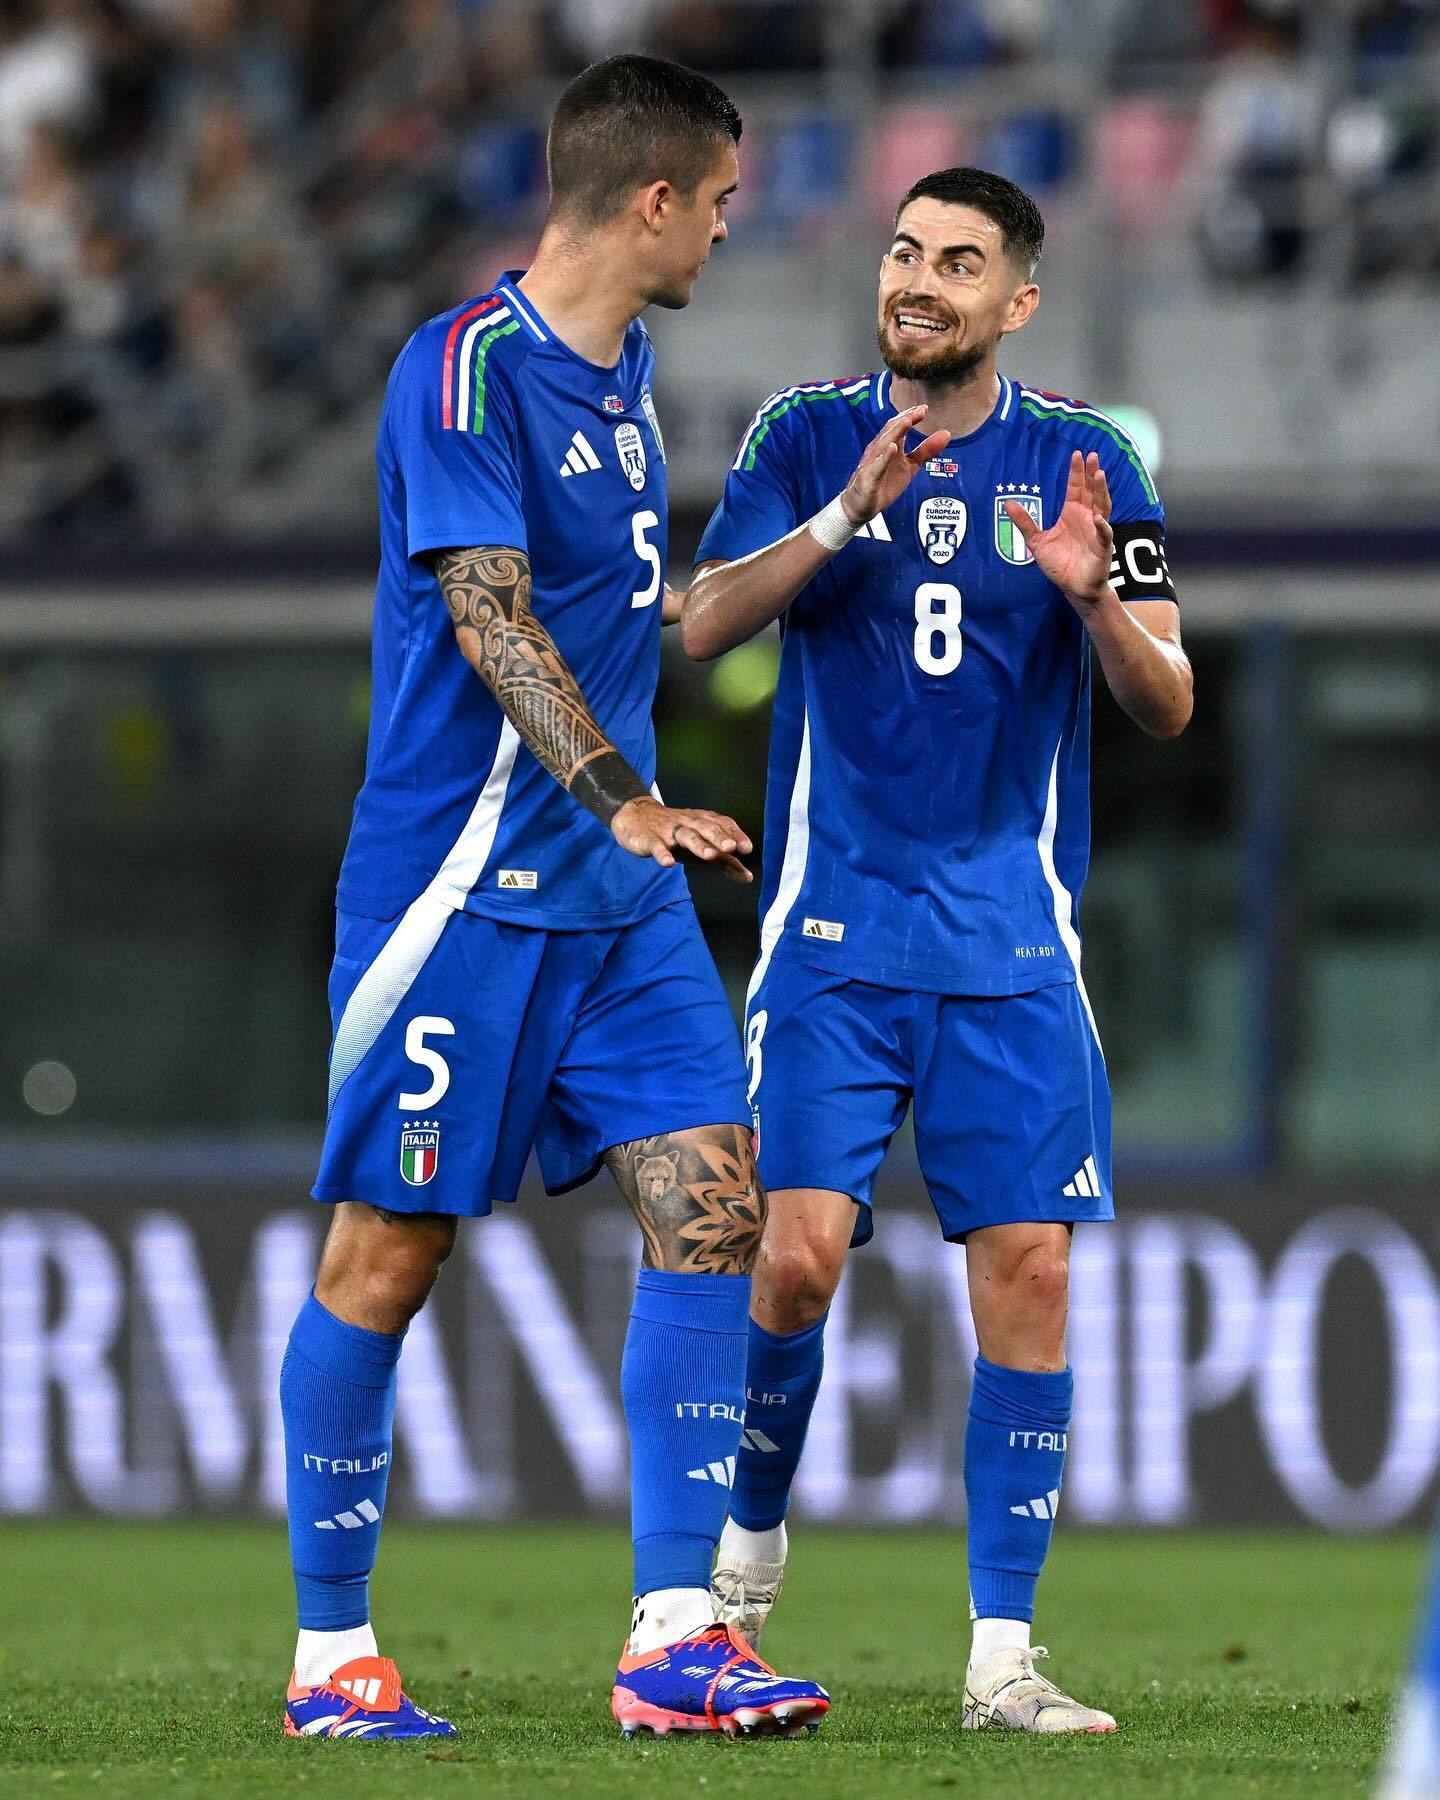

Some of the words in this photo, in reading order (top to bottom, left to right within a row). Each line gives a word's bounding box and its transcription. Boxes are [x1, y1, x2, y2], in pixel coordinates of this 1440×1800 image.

[631, 510, 661, 609] 5
[914, 582, 963, 676] 8
[1015, 946, 1055, 958] HEAT.RDY
[398, 1015, 456, 1112] 5
[404, 1134, 436, 1146] ITALIA
[303, 1451, 388, 1475] ITALIA
